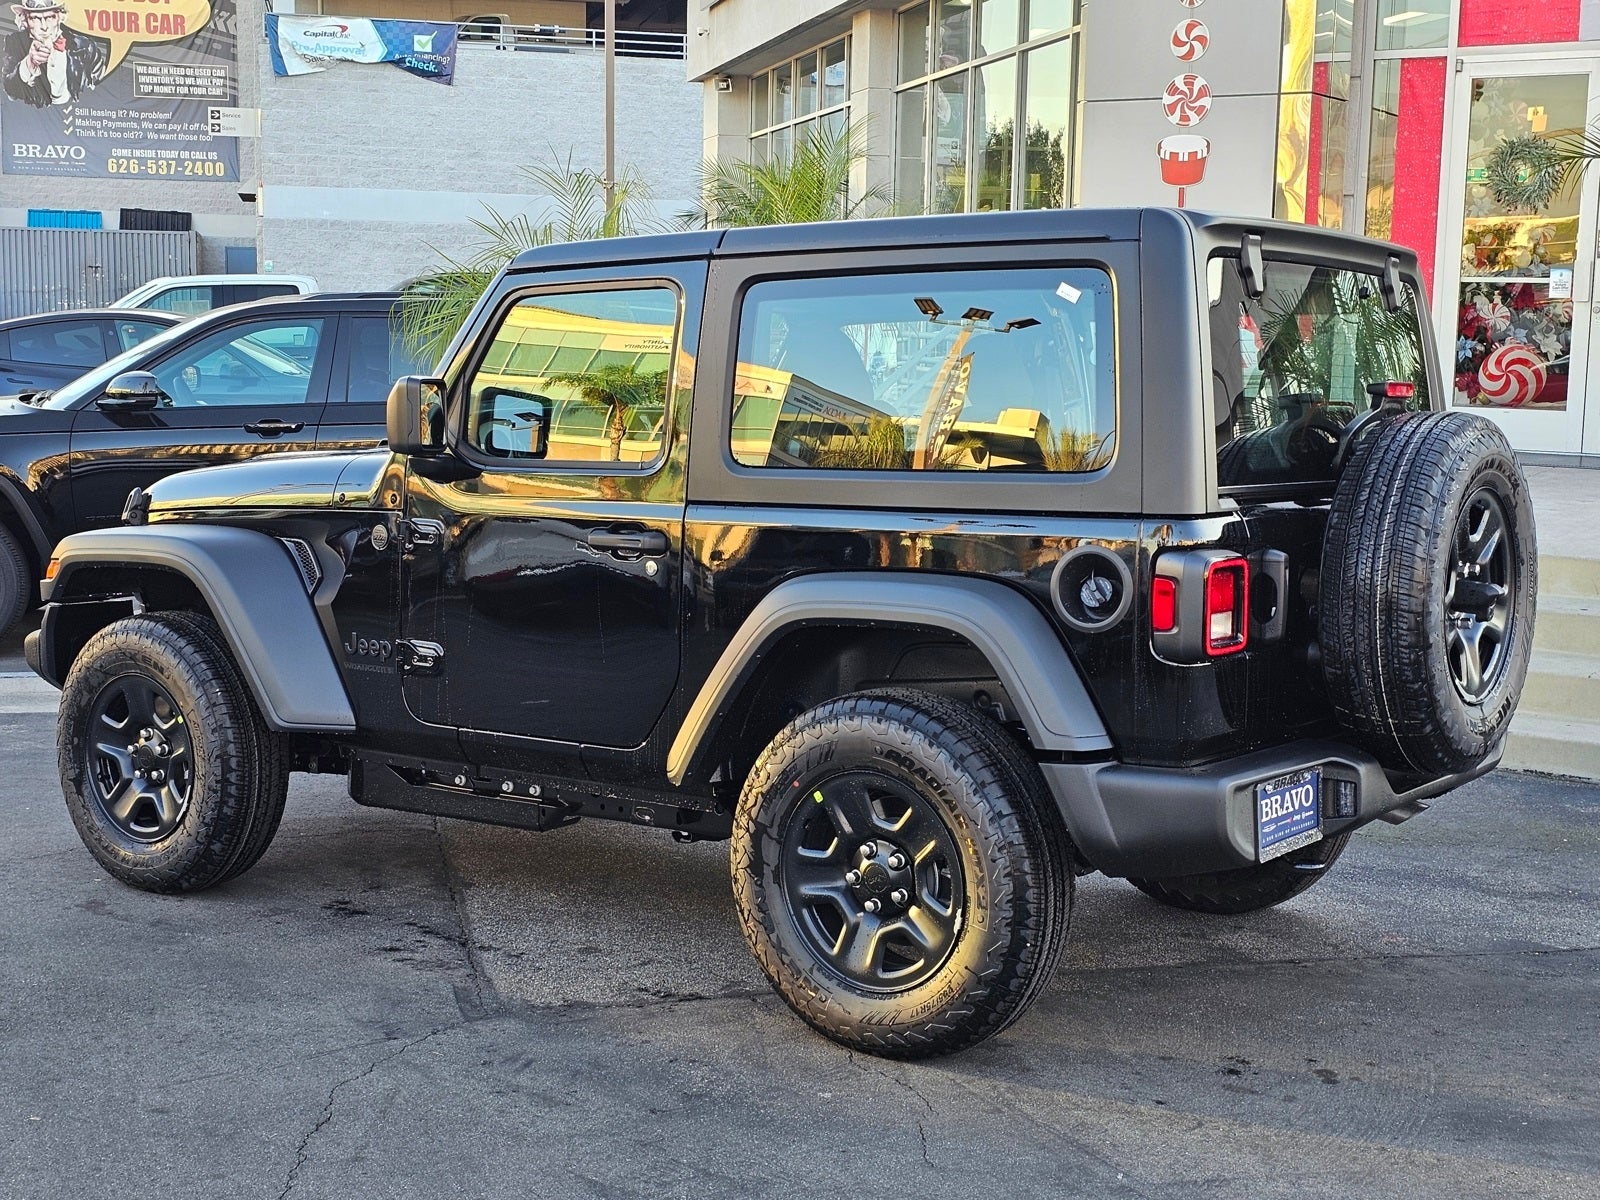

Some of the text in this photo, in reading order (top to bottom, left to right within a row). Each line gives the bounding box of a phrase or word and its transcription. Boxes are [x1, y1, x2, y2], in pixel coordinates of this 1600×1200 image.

[84, 9, 186, 35] YOUR CAR
[136, 65, 226, 77] WE ARE IN NEED OF USED CAR
[405, 57, 438, 72] Check.
[175, 77, 184, 85] SO
[184, 77, 196, 85] WE
[196, 77, 212, 86] WILL
[212, 78, 224, 86] PAY
[140, 84, 224, 96] TOP MONEY FOR YOUR CAR!
[74, 108, 172, 120] Still leasing it? No problem!
[75, 118, 101, 129] Making
[102, 119, 140, 130] Payments,
[141, 121, 153, 129] We
[168, 123, 181, 132] pay
[182, 122, 188, 131] it
[189, 122, 200, 131] off
[200, 123, 209, 131] fo
[75, 128, 96, 137] Think
[97, 129, 108, 138] it's
[109, 130, 122, 138] too
[123, 131, 143, 139] old??
[147, 131, 158, 140] We
[178, 132, 198, 141] those
[12, 143, 86, 159] BRAVO
[111, 148, 218, 160] COME INSIDE TODAY OR CALL US
[107, 158, 225, 177] 626-537-2400
[344, 631, 392, 664] Jeep
[1260, 784, 1314, 823] BRAVO
